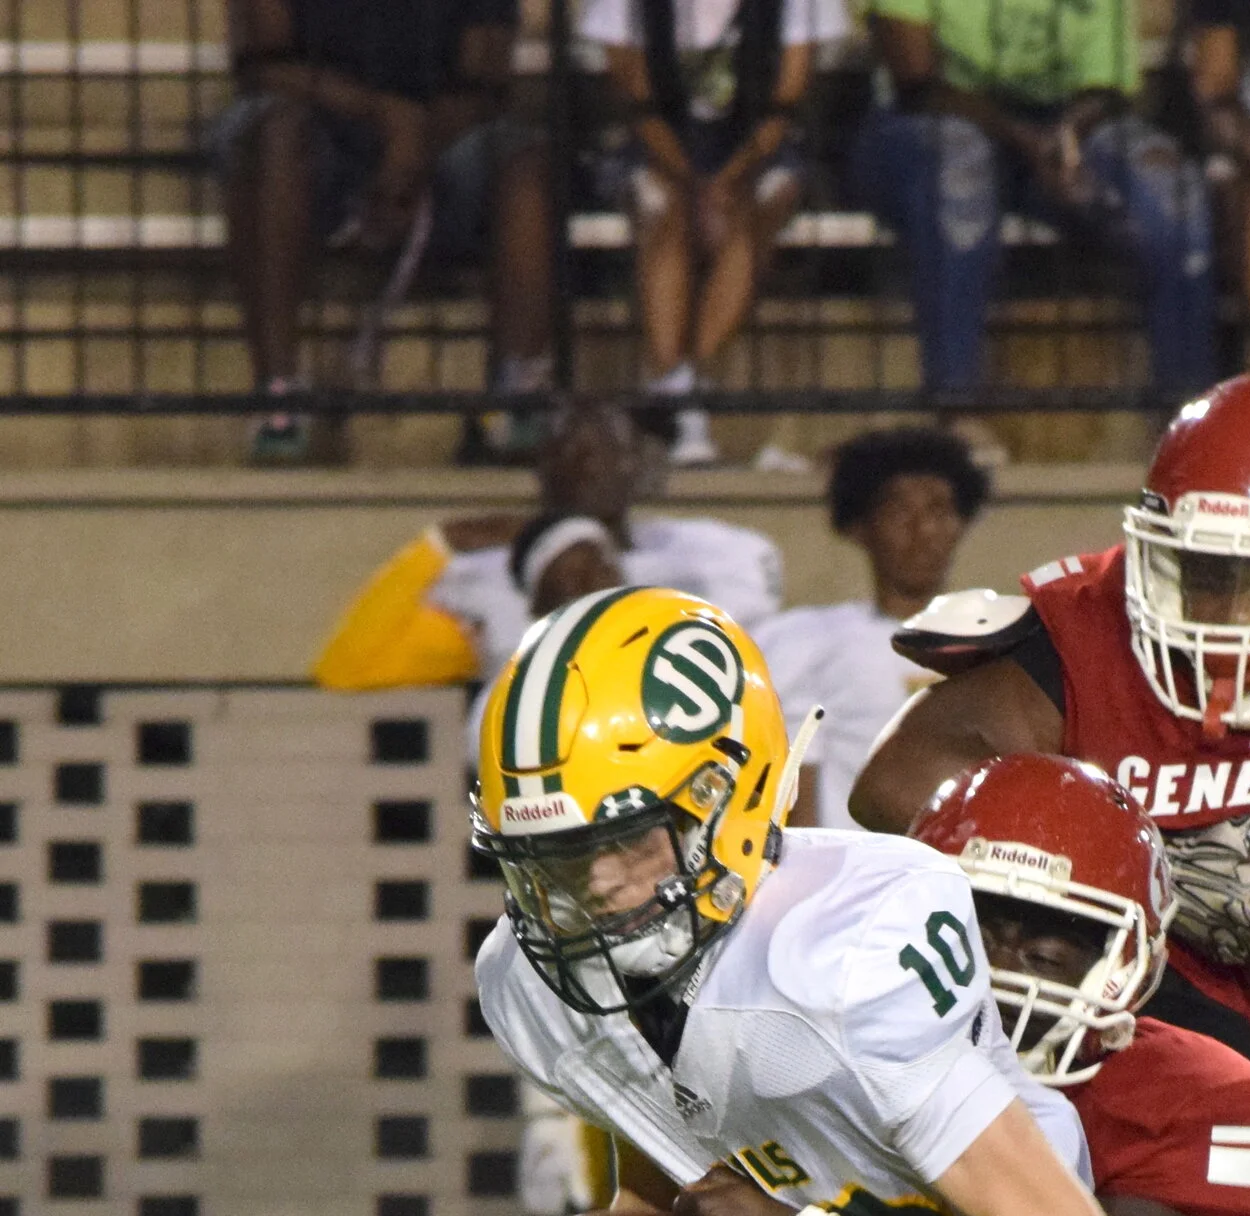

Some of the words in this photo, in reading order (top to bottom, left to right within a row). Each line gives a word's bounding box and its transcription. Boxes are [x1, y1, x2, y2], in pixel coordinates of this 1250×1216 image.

[1197, 499, 1250, 517] Riddell
[653, 627, 739, 731] JD
[504, 804, 565, 822] Riddell
[990, 846, 1048, 871] Riddell
[898, 910, 976, 1019] 10
